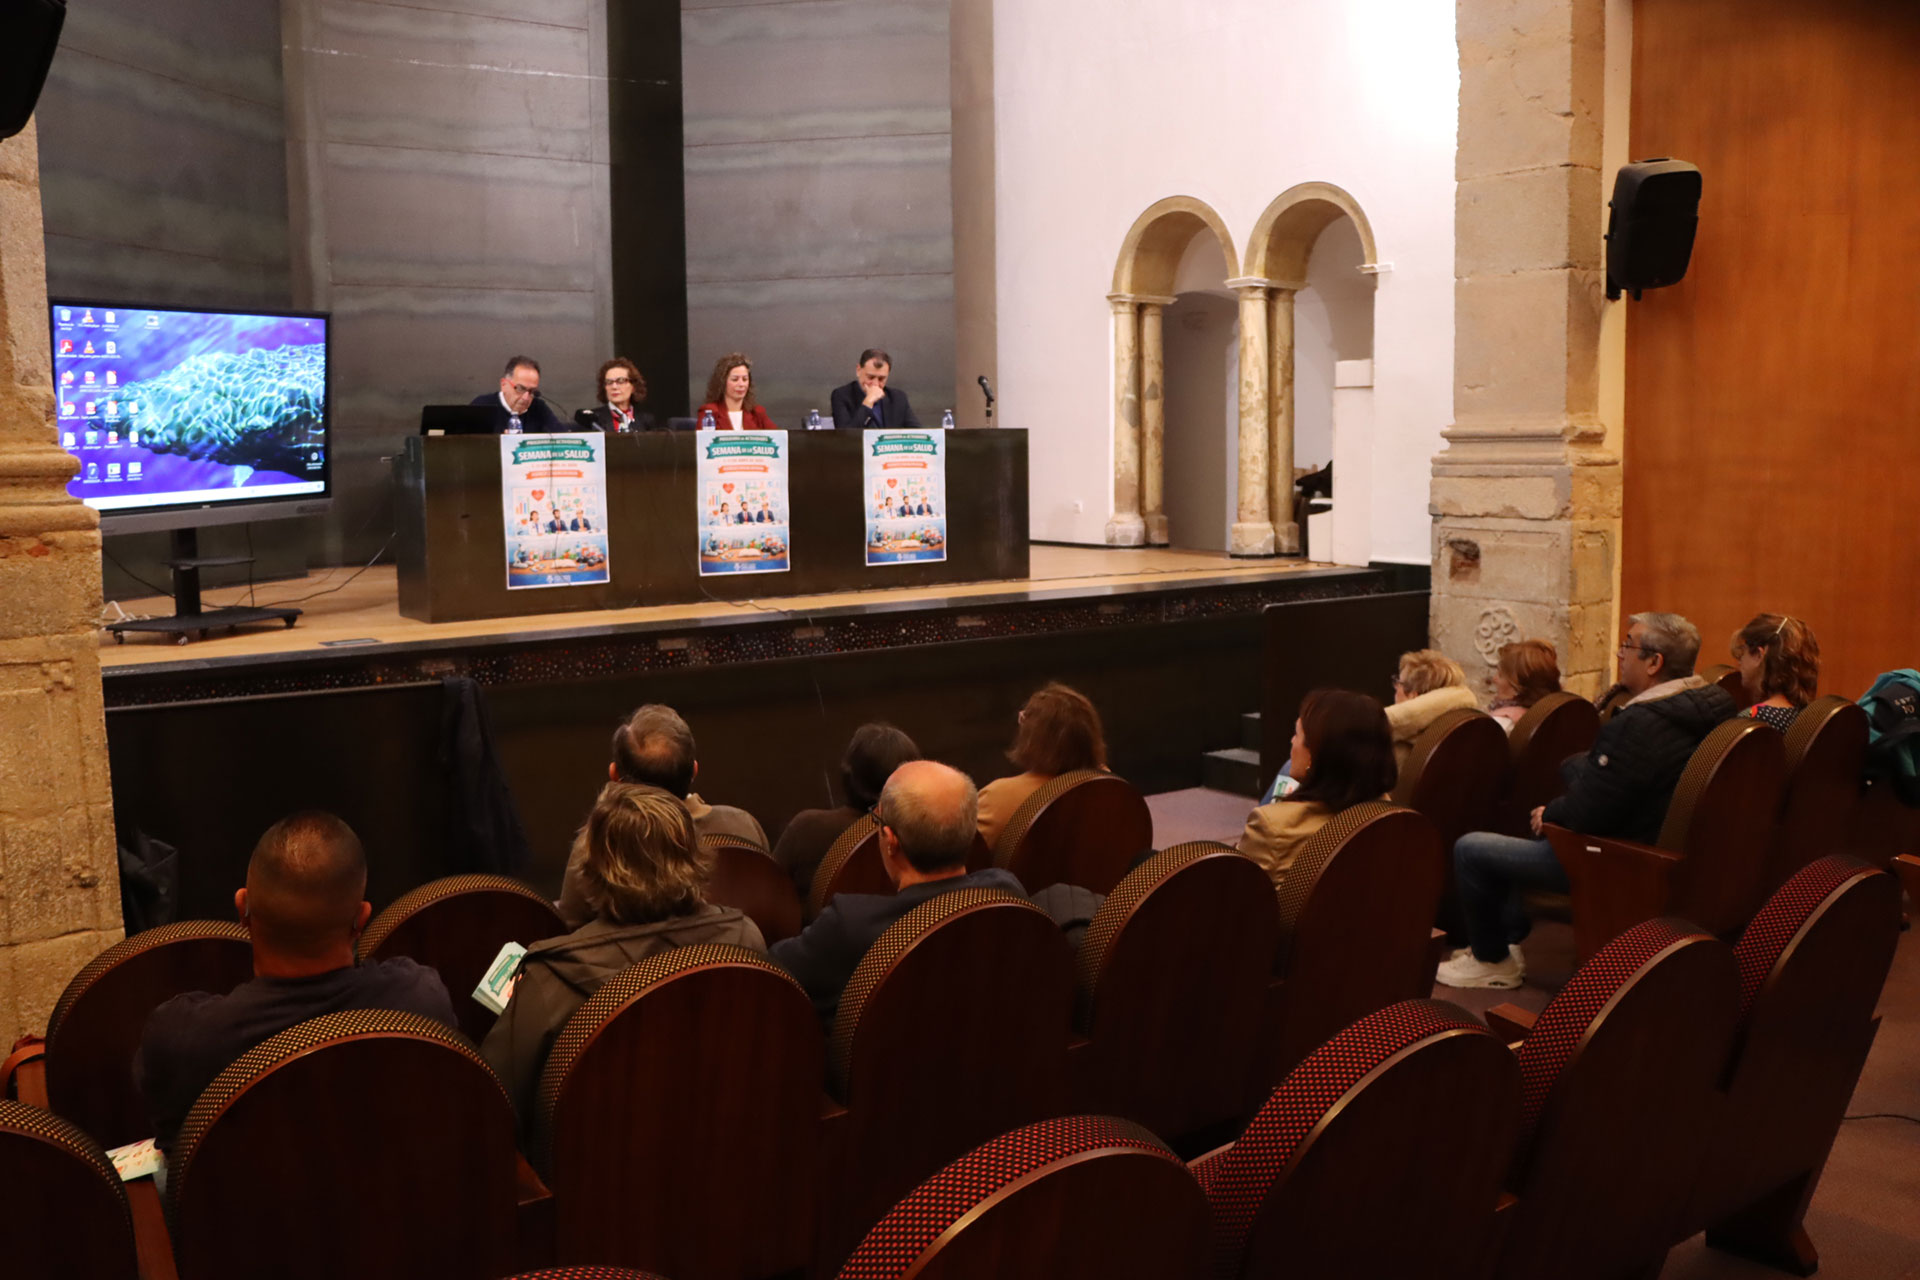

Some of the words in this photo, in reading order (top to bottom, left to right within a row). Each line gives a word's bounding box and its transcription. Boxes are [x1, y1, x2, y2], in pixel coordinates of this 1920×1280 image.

[712, 446, 741, 456] SEMANA
[753, 446, 775, 455] SALUD
[877, 444, 903, 452] SEMANA
[913, 444, 933, 452] SALUD
[518, 450, 551, 460] SEMANA
[564, 450, 590, 459] SALUD
